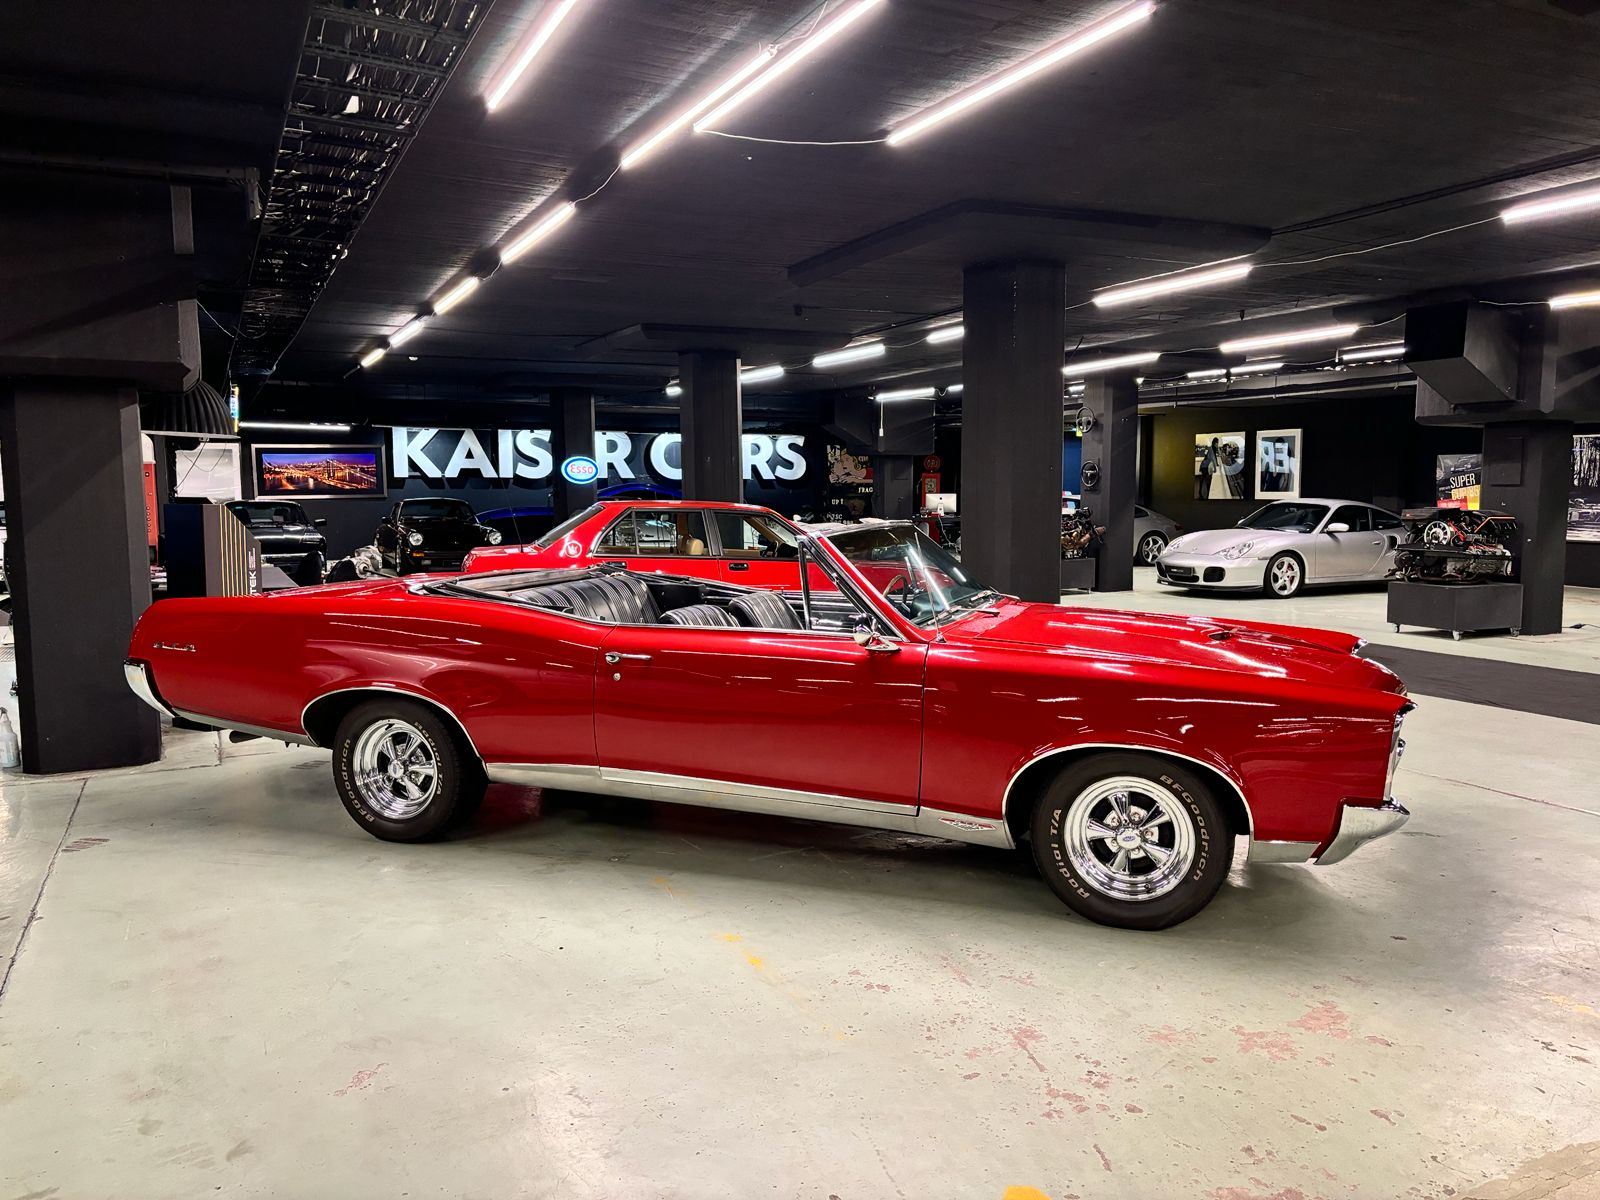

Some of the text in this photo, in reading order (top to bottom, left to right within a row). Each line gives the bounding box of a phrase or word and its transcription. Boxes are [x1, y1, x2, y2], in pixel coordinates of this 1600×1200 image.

[392, 426, 807, 481] KAISR CRS
[1449, 472, 1476, 489] SUPER
[341, 739, 375, 823] BFGoodrich
[1050, 808, 1062, 837] T/A
[1159, 774, 1210, 881] BFGoodrich
